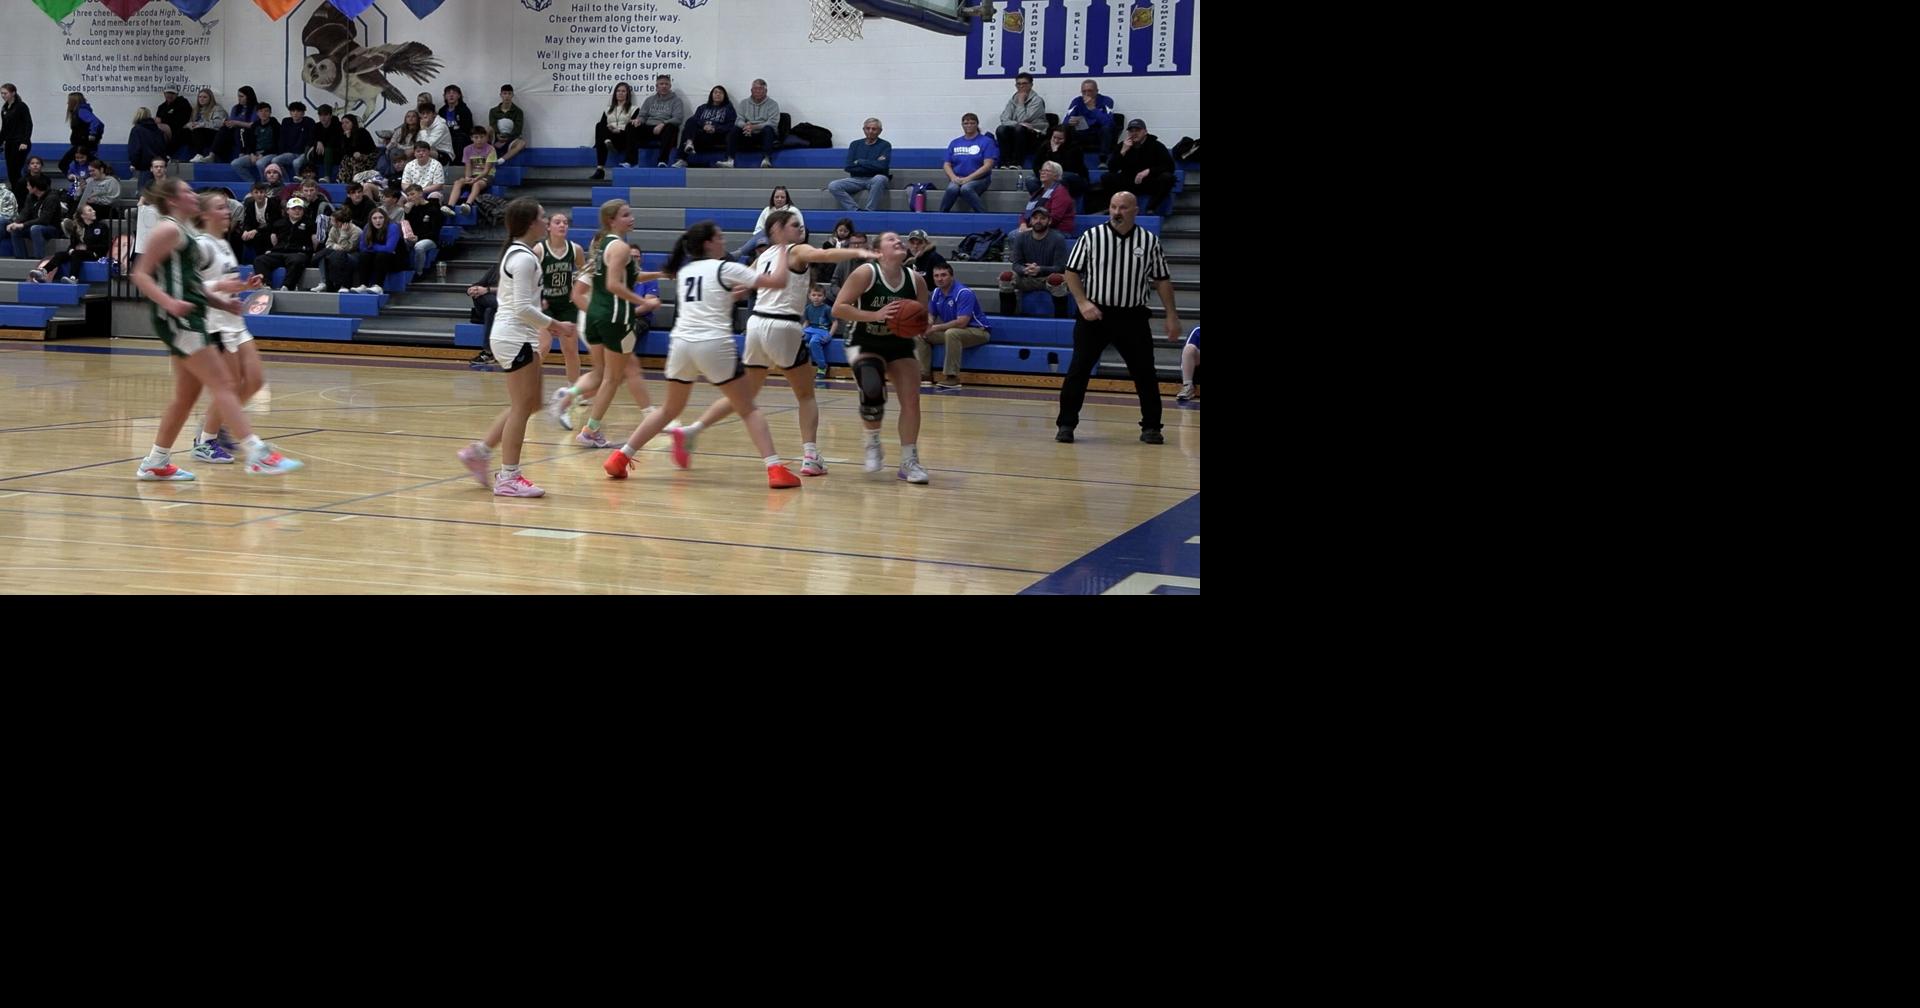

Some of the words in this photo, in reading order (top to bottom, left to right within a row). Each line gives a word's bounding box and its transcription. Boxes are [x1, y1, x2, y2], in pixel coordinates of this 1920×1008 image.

[571, 3, 590, 12] Hail
[592, 4, 602, 12] to
[604, 3, 619, 12] the
[621, 2, 658, 13] Varsity,
[159, 9, 176, 18] High
[549, 14, 577, 23] Cheer
[579, 14, 603, 23] them
[605, 13, 632, 24] along
[634, 13, 657, 22] their
[659, 14, 681, 24] way.
[1031, 2, 1039, 26] HARD
[92, 19, 106, 27] And
[141, 19, 149, 27] of
[150, 19, 162, 27] her
[570, 24, 607, 33] Onward
[608, 24, 619, 33] to
[621, 23, 658, 34] Victory,
[90, 28, 108, 38] Long
[109, 29, 123, 38] may
[136, 28, 151, 37] play
[152, 28, 165, 36] the
[165, 29, 185, 38] game
[1072, 11, 1081, 61] SKILLED
[1115, 3, 1125, 67] RESILIENT
[1159, 0, 1169, 68] COMPASSIONATE
[66, 38, 81, 46] And
[81, 38, 102, 46] count
[103, 38, 120, 46] each
[141, 38, 167, 47] victory
[168, 37, 180, 46] GO
[545, 35, 564, 45] May
[566, 35, 587, 46] they
[589, 35, 605, 44] win
[607, 34, 623, 43] the
[625, 35, 652, 45] game
[653, 34, 683, 45] today.
[988, 17, 997, 66] OSITIVE
[537, 50, 560, 59] We'll
[562, 50, 583, 61] give
[584, 51, 590, 59] a
[592, 50, 619, 59] cheer
[621, 50, 635, 58] for
[637, 49, 653, 58] the
[655, 49, 692, 60] Varsity,
[1029, 30, 1039, 72] WORKING
[63, 53, 80, 61] We'll
[183, 54, 211, 63] players
[101, 64, 118, 73] help
[542, 61, 566, 72] Long
[568, 62, 588, 72] may
[589, 61, 611, 72] they
[612, 61, 638, 72] reign
[640, 62, 686, 71] supreme.
[81, 73, 103, 81] That's
[104, 73, 122, 81] what
[154, 74, 164, 83] by
[552, 72, 580, 81] Shout
[582, 72, 595, 81] till
[597, 72, 613, 81] the
[614, 72, 649, 81] echoes
[62, 83, 81, 92] Good
[82, 84, 136, 93] sportsmanship
[136, 84, 150, 92] and
[553, 83, 569, 92] For
[571, 83, 586, 92] the
[588, 84, 613, 94] glory
[684, 275, 703, 302] 21
